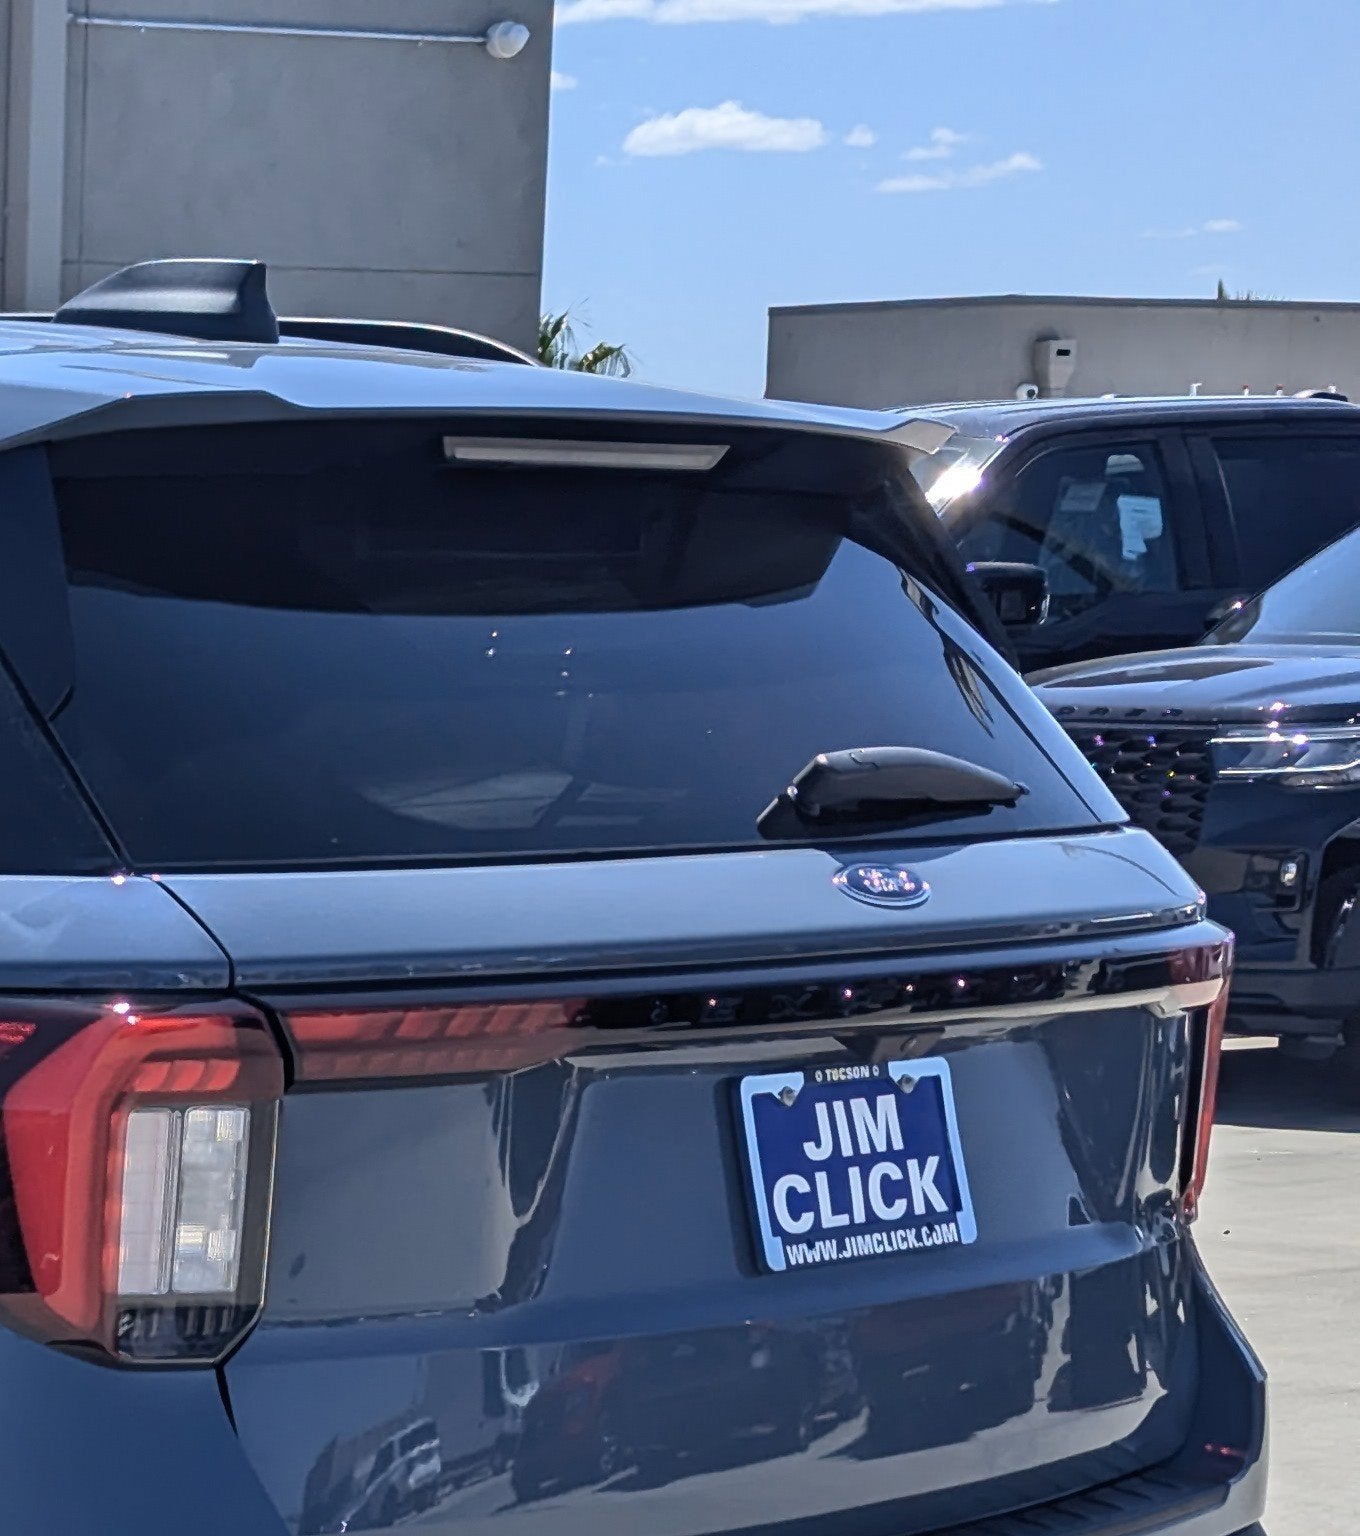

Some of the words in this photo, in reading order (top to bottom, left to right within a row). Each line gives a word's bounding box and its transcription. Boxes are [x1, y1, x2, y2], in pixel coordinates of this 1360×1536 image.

[824, 1065, 870, 1082] TUCSON
[802, 1093, 904, 1162] JIM
[772, 1154, 949, 1235] CLICK
[784, 1222, 959, 1266] WWW.JIMCLICK.COM
